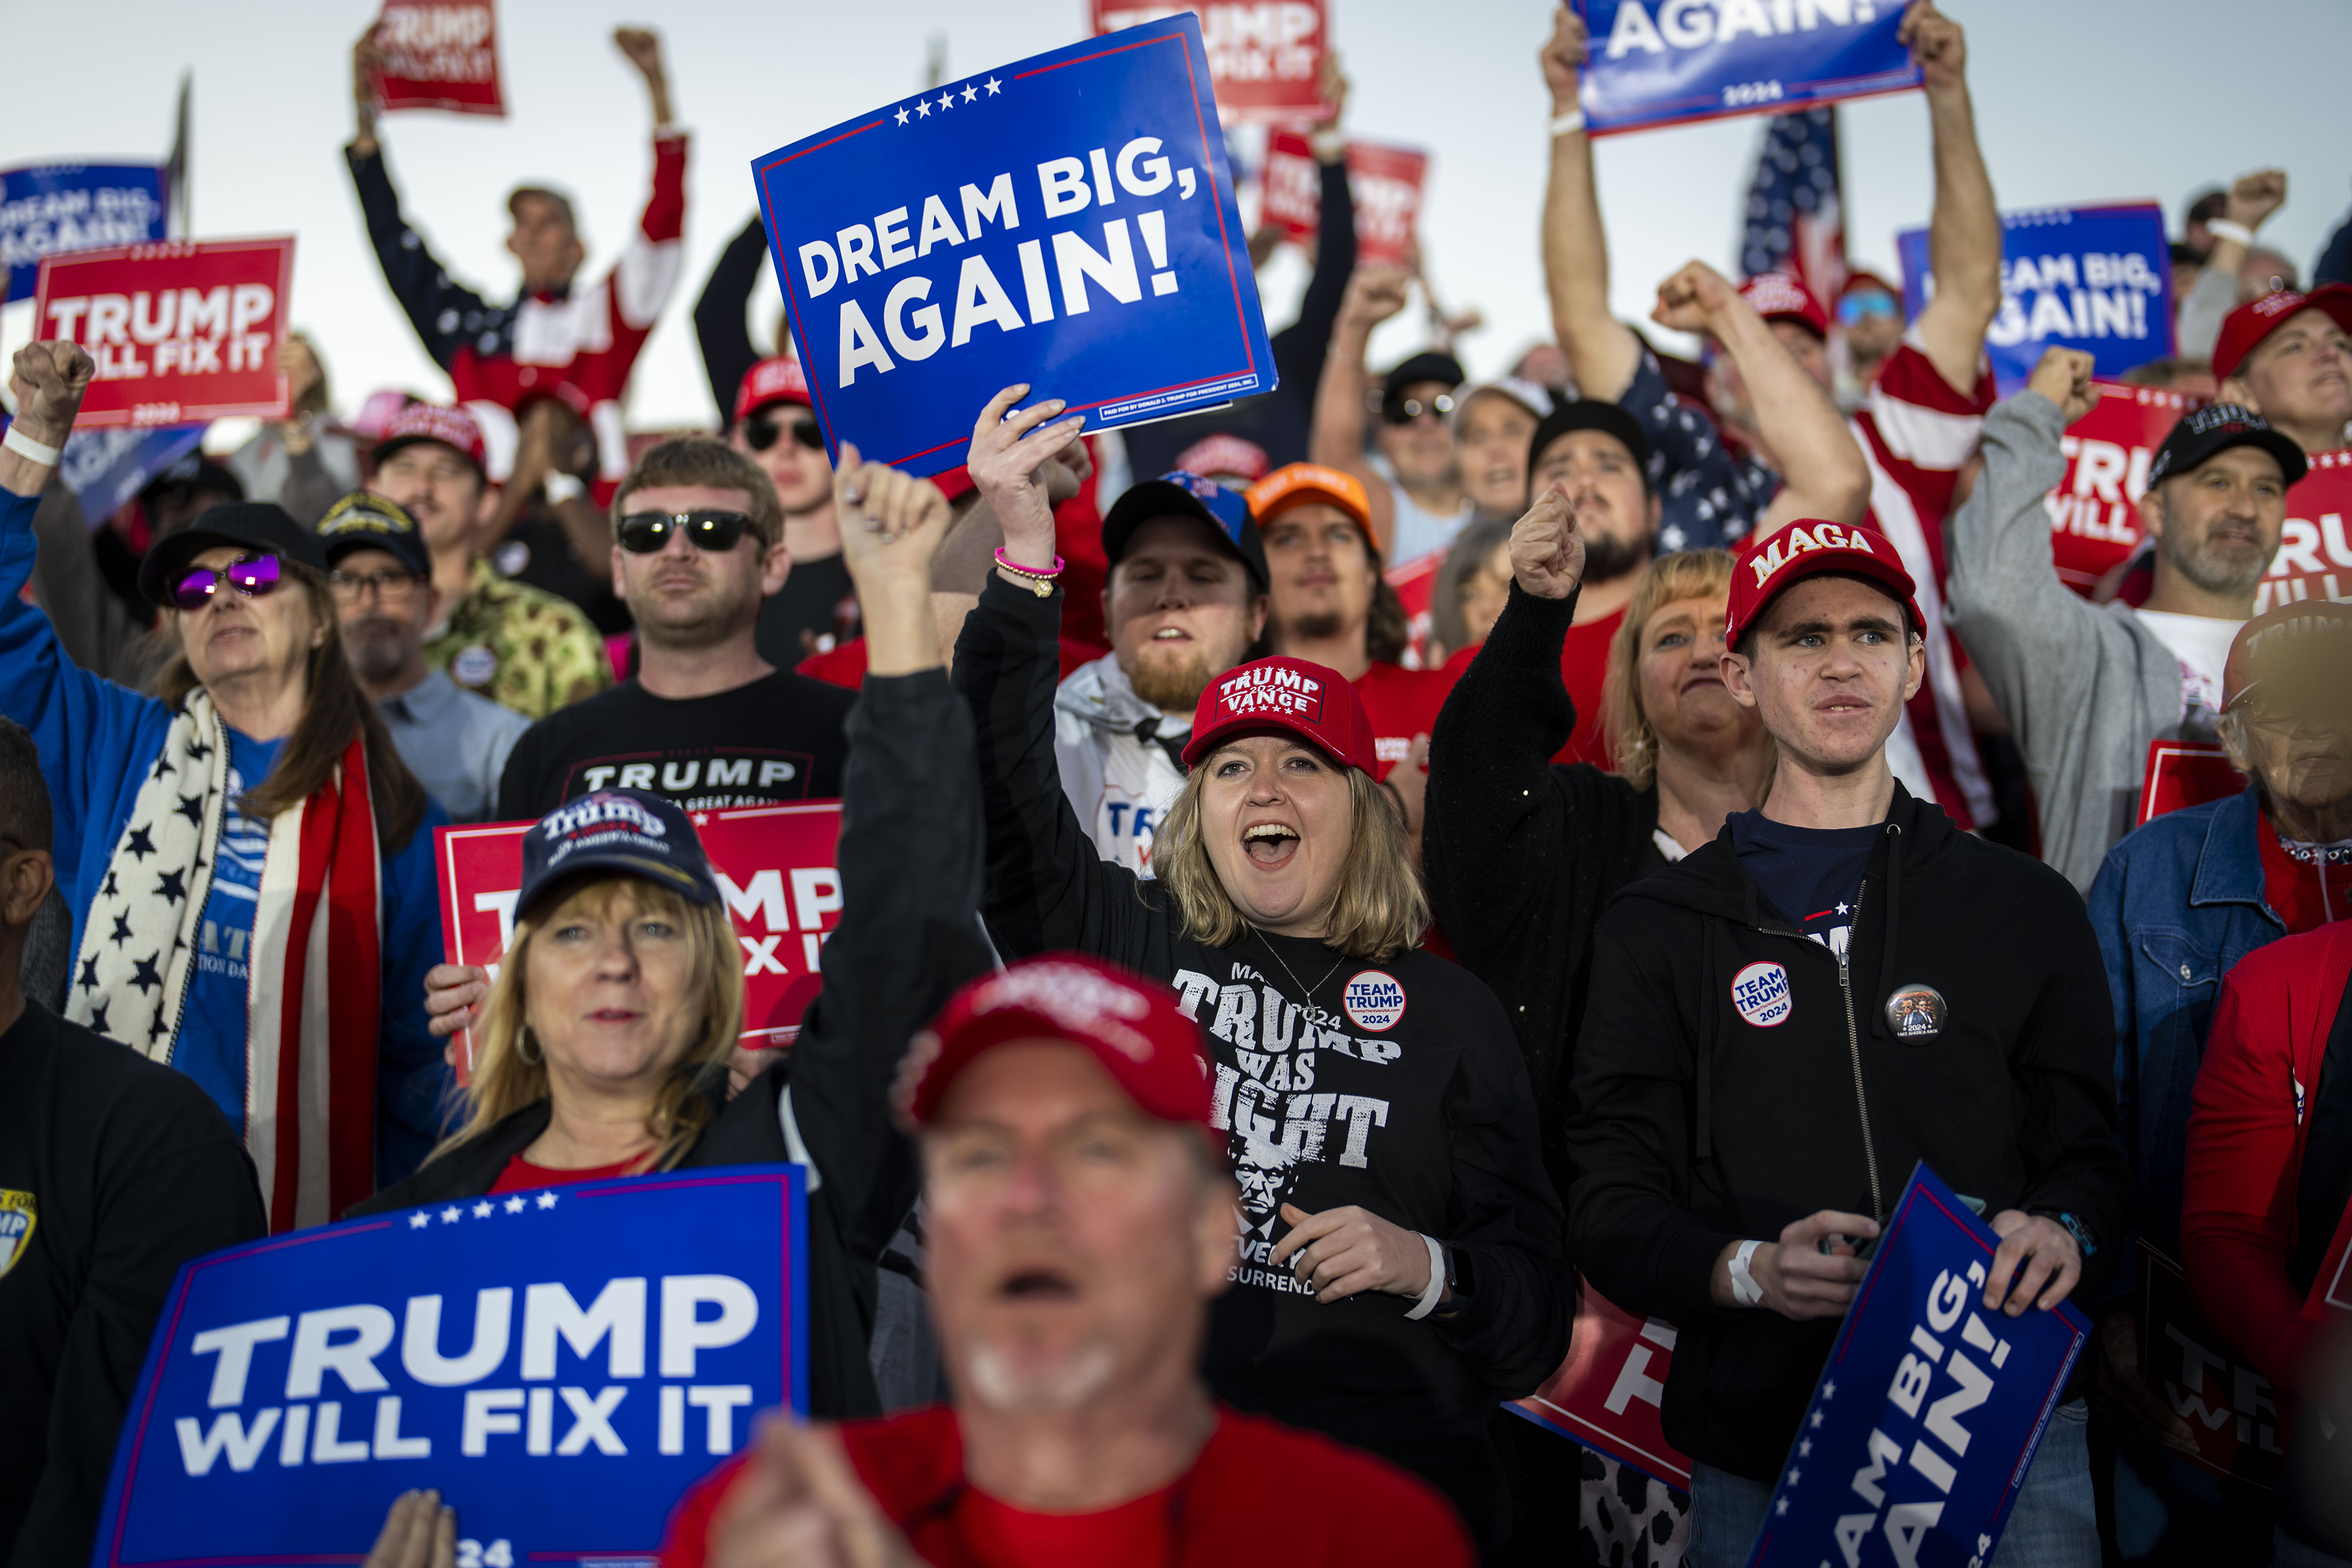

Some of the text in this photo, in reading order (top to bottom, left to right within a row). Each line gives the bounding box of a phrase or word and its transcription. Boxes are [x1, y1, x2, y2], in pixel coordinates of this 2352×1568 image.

[798, 172, 1019, 299] DREAM
[1037, 137, 1196, 219] BIG,
[47, 282, 274, 346] TRUMP
[840, 210, 1179, 389] AGAIN!
[1986, 286, 2149, 347] GAIN!
[89, 331, 271, 381] ILL FIX IT
[1138, 399, 1160, 410] DONALD
[1166, 394, 1185, 403] TRUMP
[1198, 385, 1227, 397] PRESIDENT
[1750, 523, 1874, 589] MAGA
[1220, 668, 1319, 696] TRUMP
[1249, 685, 1285, 694] 2024
[1228, 690, 1308, 713] VANCE
[583, 758, 796, 792] TRUMP
[686, 794, 732, 812] GREAT
[1350, 983, 1397, 996] TEAM
[1735, 968, 1783, 998] TEAM
[1736, 976, 1789, 1012] TRUMP
[1172, 968, 1402, 1066] TRUMP
[1346, 996, 1403, 1008] TRUMP
[1362, 1015, 1390, 1024] 2024
[1759, 1002, 1788, 1022] 2024
[1235, 1047, 1316, 1092] WAS
[191, 1273, 759, 1408] TRUMP
[1887, 1260, 1986, 1419] BIG,
[175, 1385, 752, 1476] WILL FIX IT
